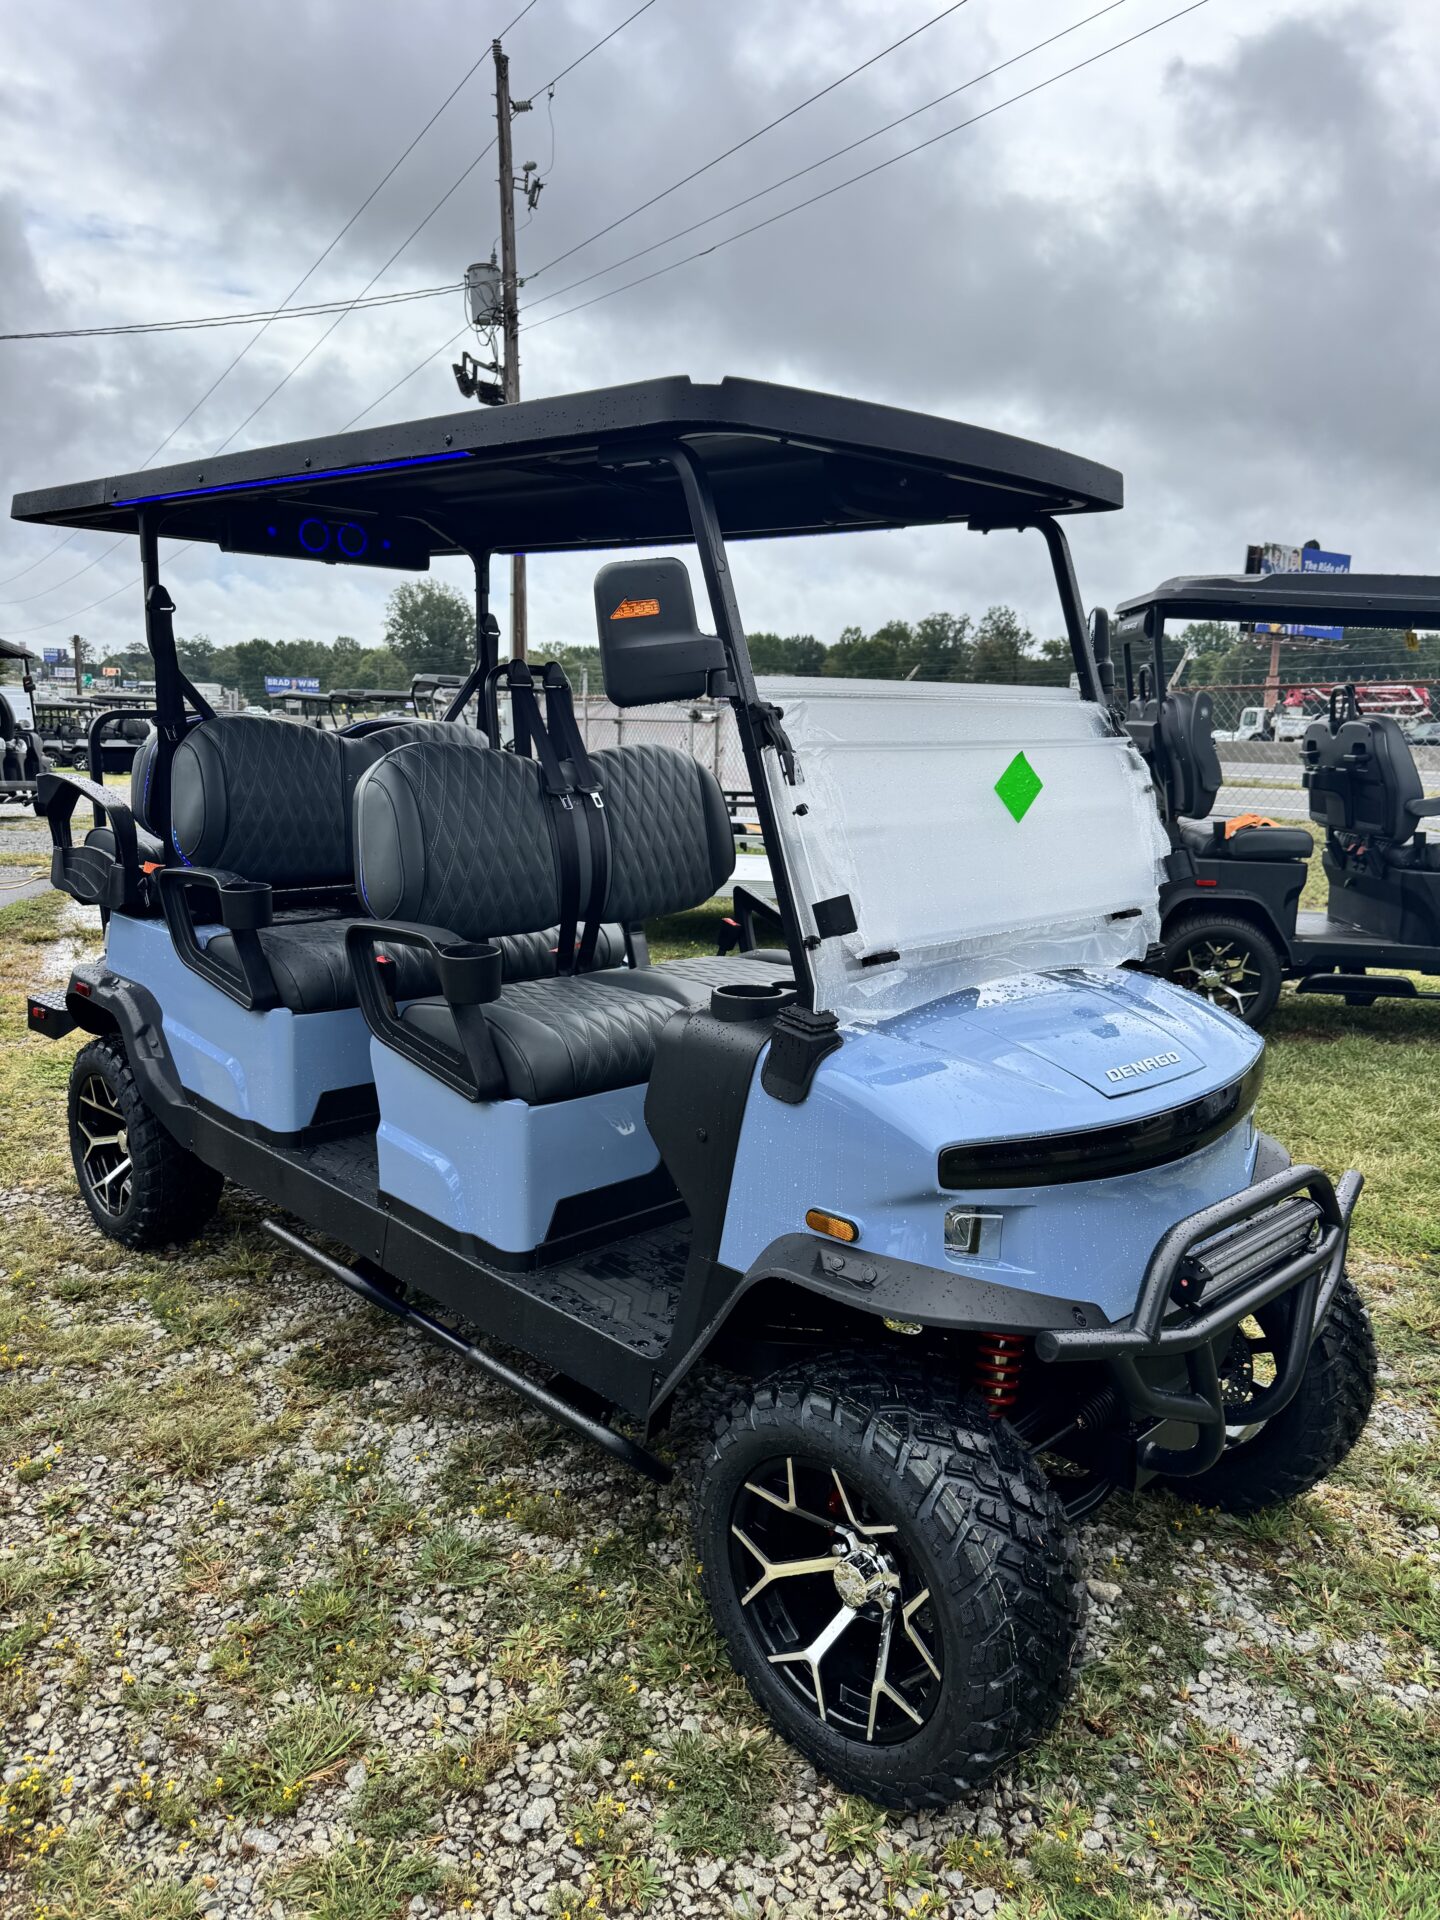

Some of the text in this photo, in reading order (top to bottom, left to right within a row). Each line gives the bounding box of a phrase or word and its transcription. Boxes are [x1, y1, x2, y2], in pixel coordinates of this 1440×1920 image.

[1304, 560, 1318, 571] The
[1318, 561, 1335, 573] Ride
[267, 678, 320, 688] BRAD WINS
[1105, 1051, 1182, 1083] DENAGO
